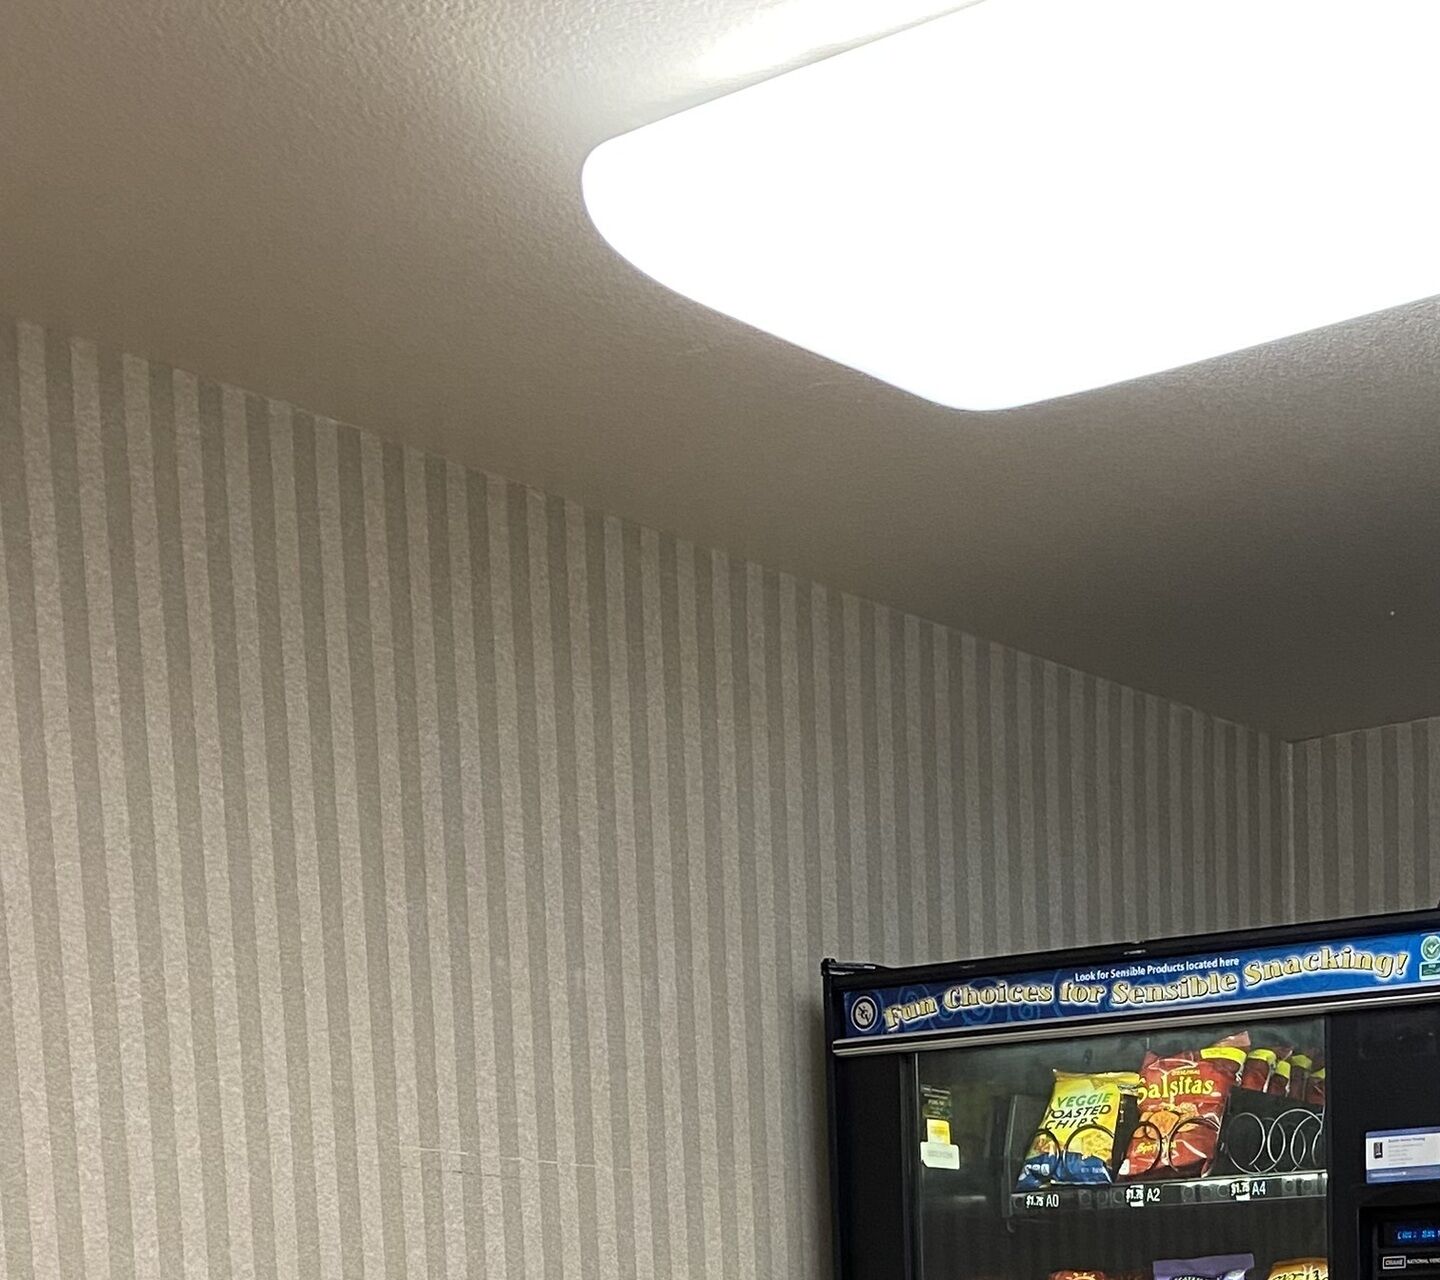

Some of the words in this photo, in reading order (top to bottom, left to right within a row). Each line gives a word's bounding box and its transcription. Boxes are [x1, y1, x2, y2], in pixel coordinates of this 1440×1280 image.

[1075, 972, 1096, 982] Look
[1096, 970, 1110, 980] for
[1110, 966, 1146, 978] Sensible
[1147, 963, 1185, 975] Products
[1185, 959, 1218, 971] located
[1219, 957, 1240, 967] here
[883, 994, 938, 1030] Fun
[943, 982, 1053, 1010] Choices
[1059, 980, 1107, 1004] for
[1110, 971, 1239, 1006] Sensible
[1243, 946, 1411, 987] Snacking!
[1055, 1093, 1114, 1108] VEGGIE
[1146, 1187, 1160, 1202] A2
[1252, 1181, 1266, 1196] A4
[1046, 1194, 1059, 1207] A0
